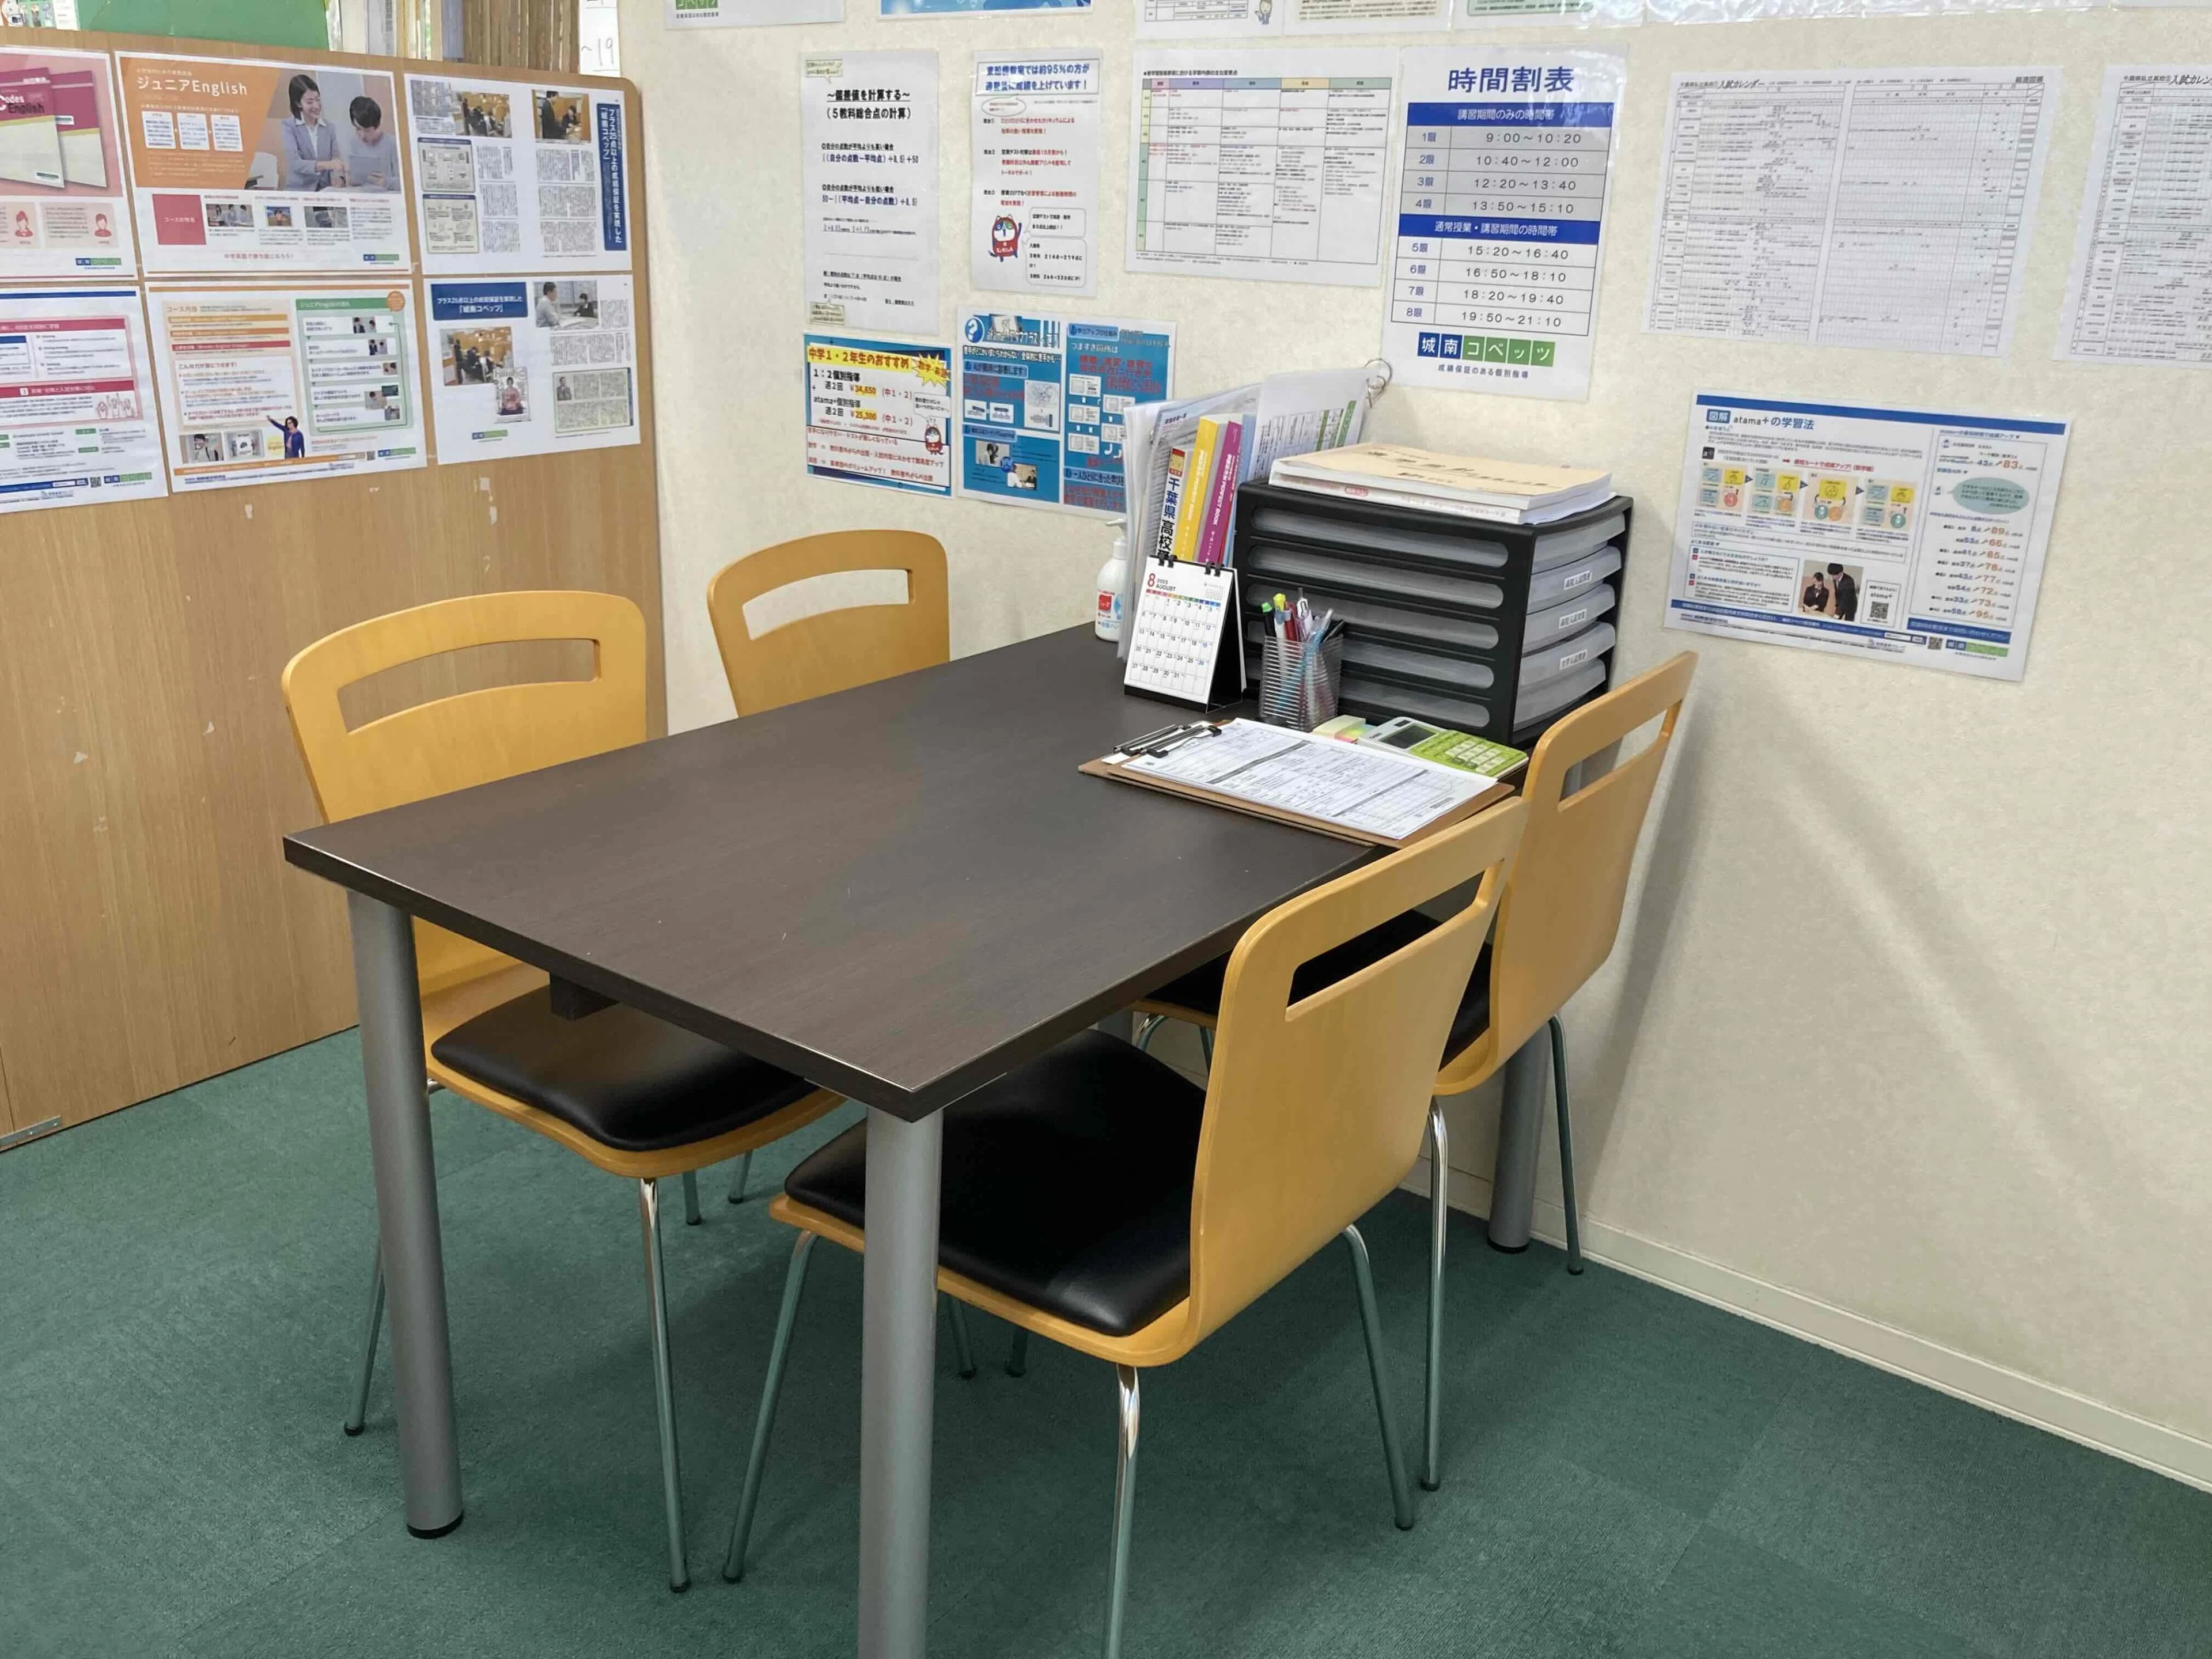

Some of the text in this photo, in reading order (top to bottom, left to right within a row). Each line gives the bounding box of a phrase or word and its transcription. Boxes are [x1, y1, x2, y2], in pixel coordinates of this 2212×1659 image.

[1448, 66, 1574, 93] 時間割表
[138, 76, 248, 97] ジュニアEnglish
[1457, 108, 1554, 121] 講習期間のみの時間帯
[1422, 132, 1437, 142] 1限
[1419, 155, 1434, 165] 2限
[1418, 177, 1434, 187] 3限
[1416, 199, 1432, 209] 4限
[1435, 222, 1558, 236] 通常授業・講習期間の時間帯
[1412, 243, 1428, 252] 5限
[1410, 265, 1426, 274] 6限
[1408, 286, 1424, 296] 7限
[1406, 308, 1422, 317] 8限
[1421, 336, 1551, 363] 城南コベッツ
[1438, 364, 1528, 379] 成績保証のある個別指導
[1147, 573, 1156, 587] 8
